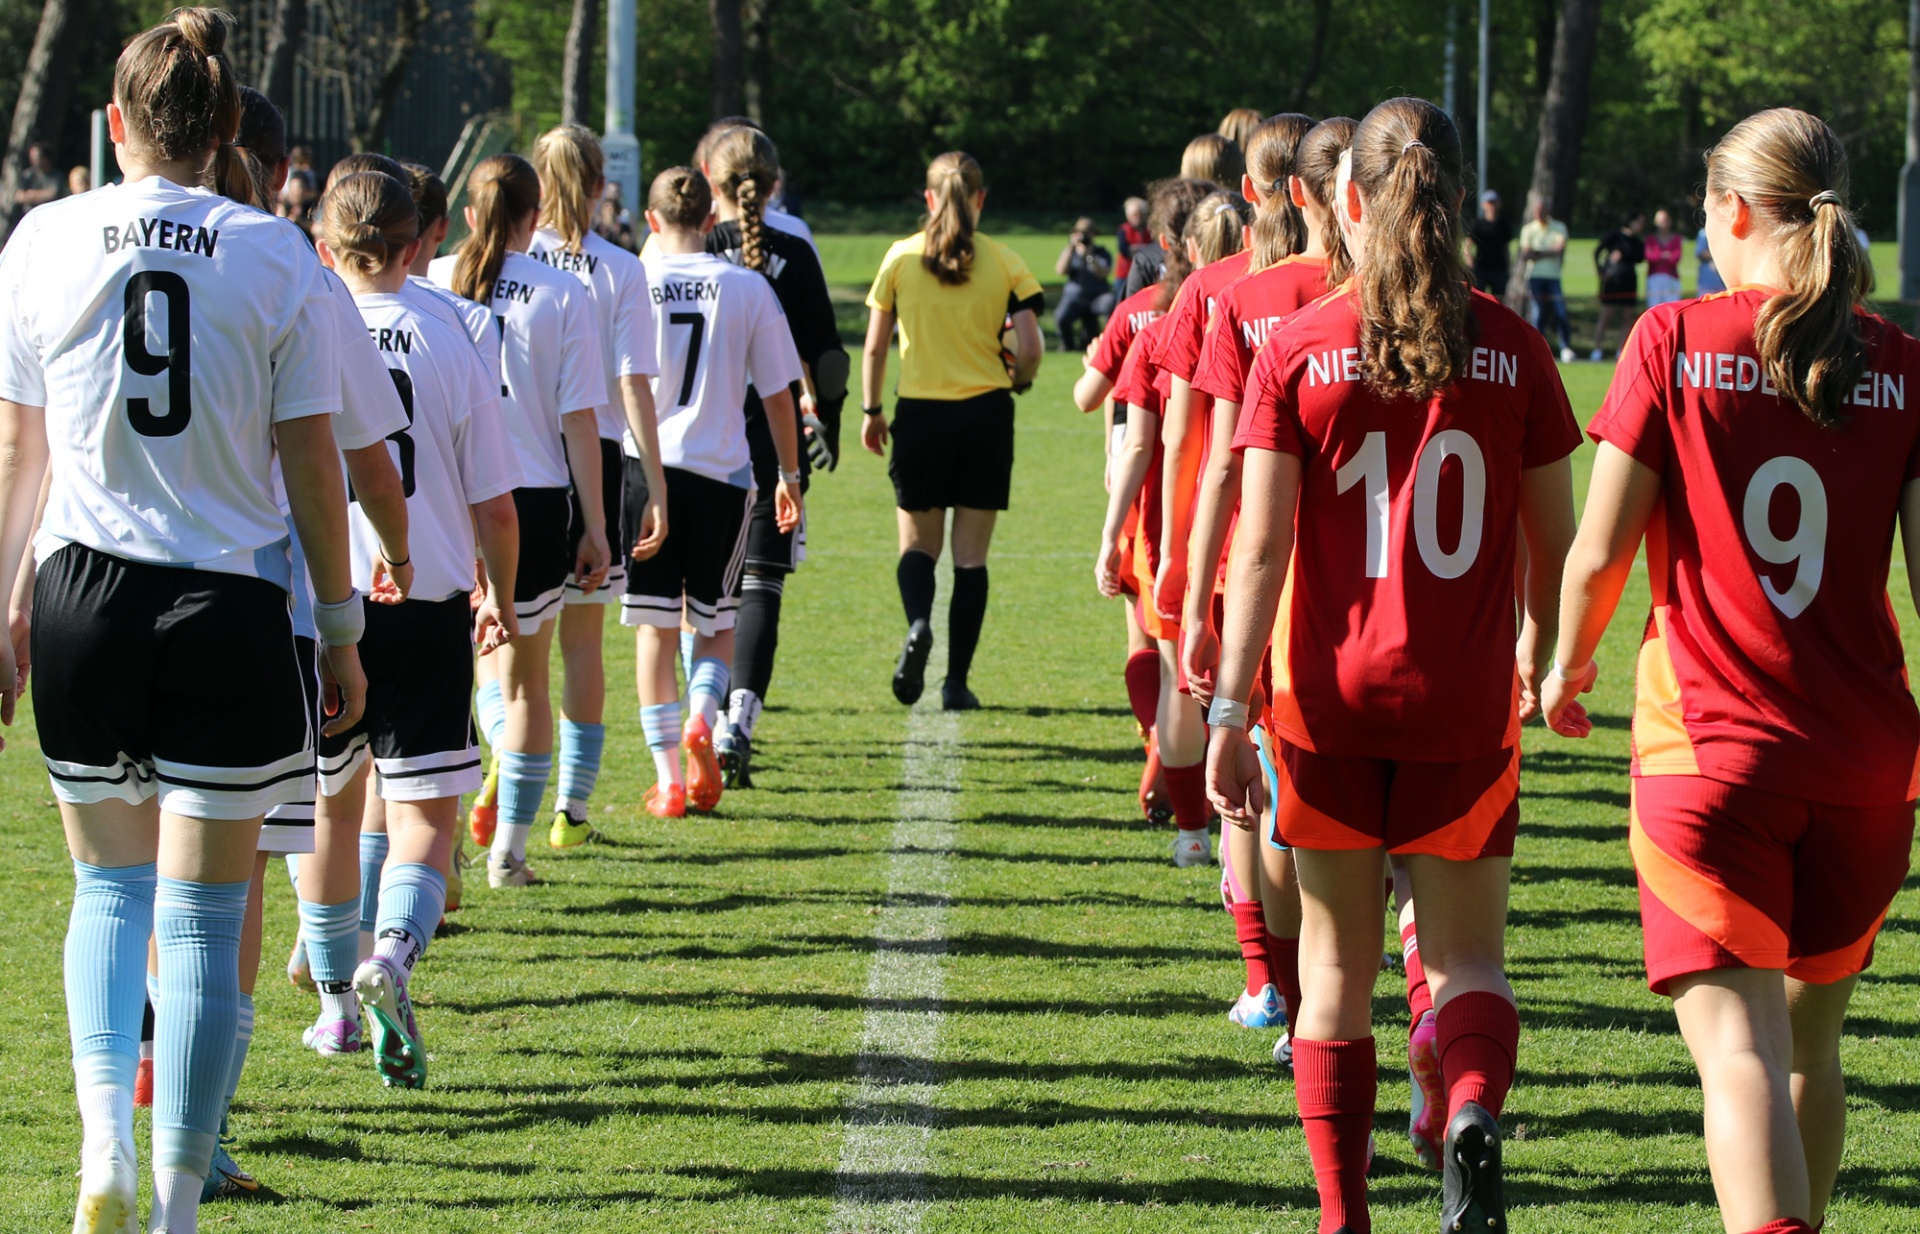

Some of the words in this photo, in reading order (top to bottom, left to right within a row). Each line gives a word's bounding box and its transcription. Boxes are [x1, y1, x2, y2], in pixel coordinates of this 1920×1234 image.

[103, 218, 219, 258] BAYERN
[495, 279, 535, 304] ERN
[651, 282, 719, 305] BAYERN
[123, 270, 192, 437] 9
[669, 312, 706, 406] 7
[1307, 347, 1518, 387] NIEEIN
[1676, 351, 1905, 410] NIEDEIN
[1336, 429, 1486, 579] 10
[1743, 455, 1828, 619] 9
